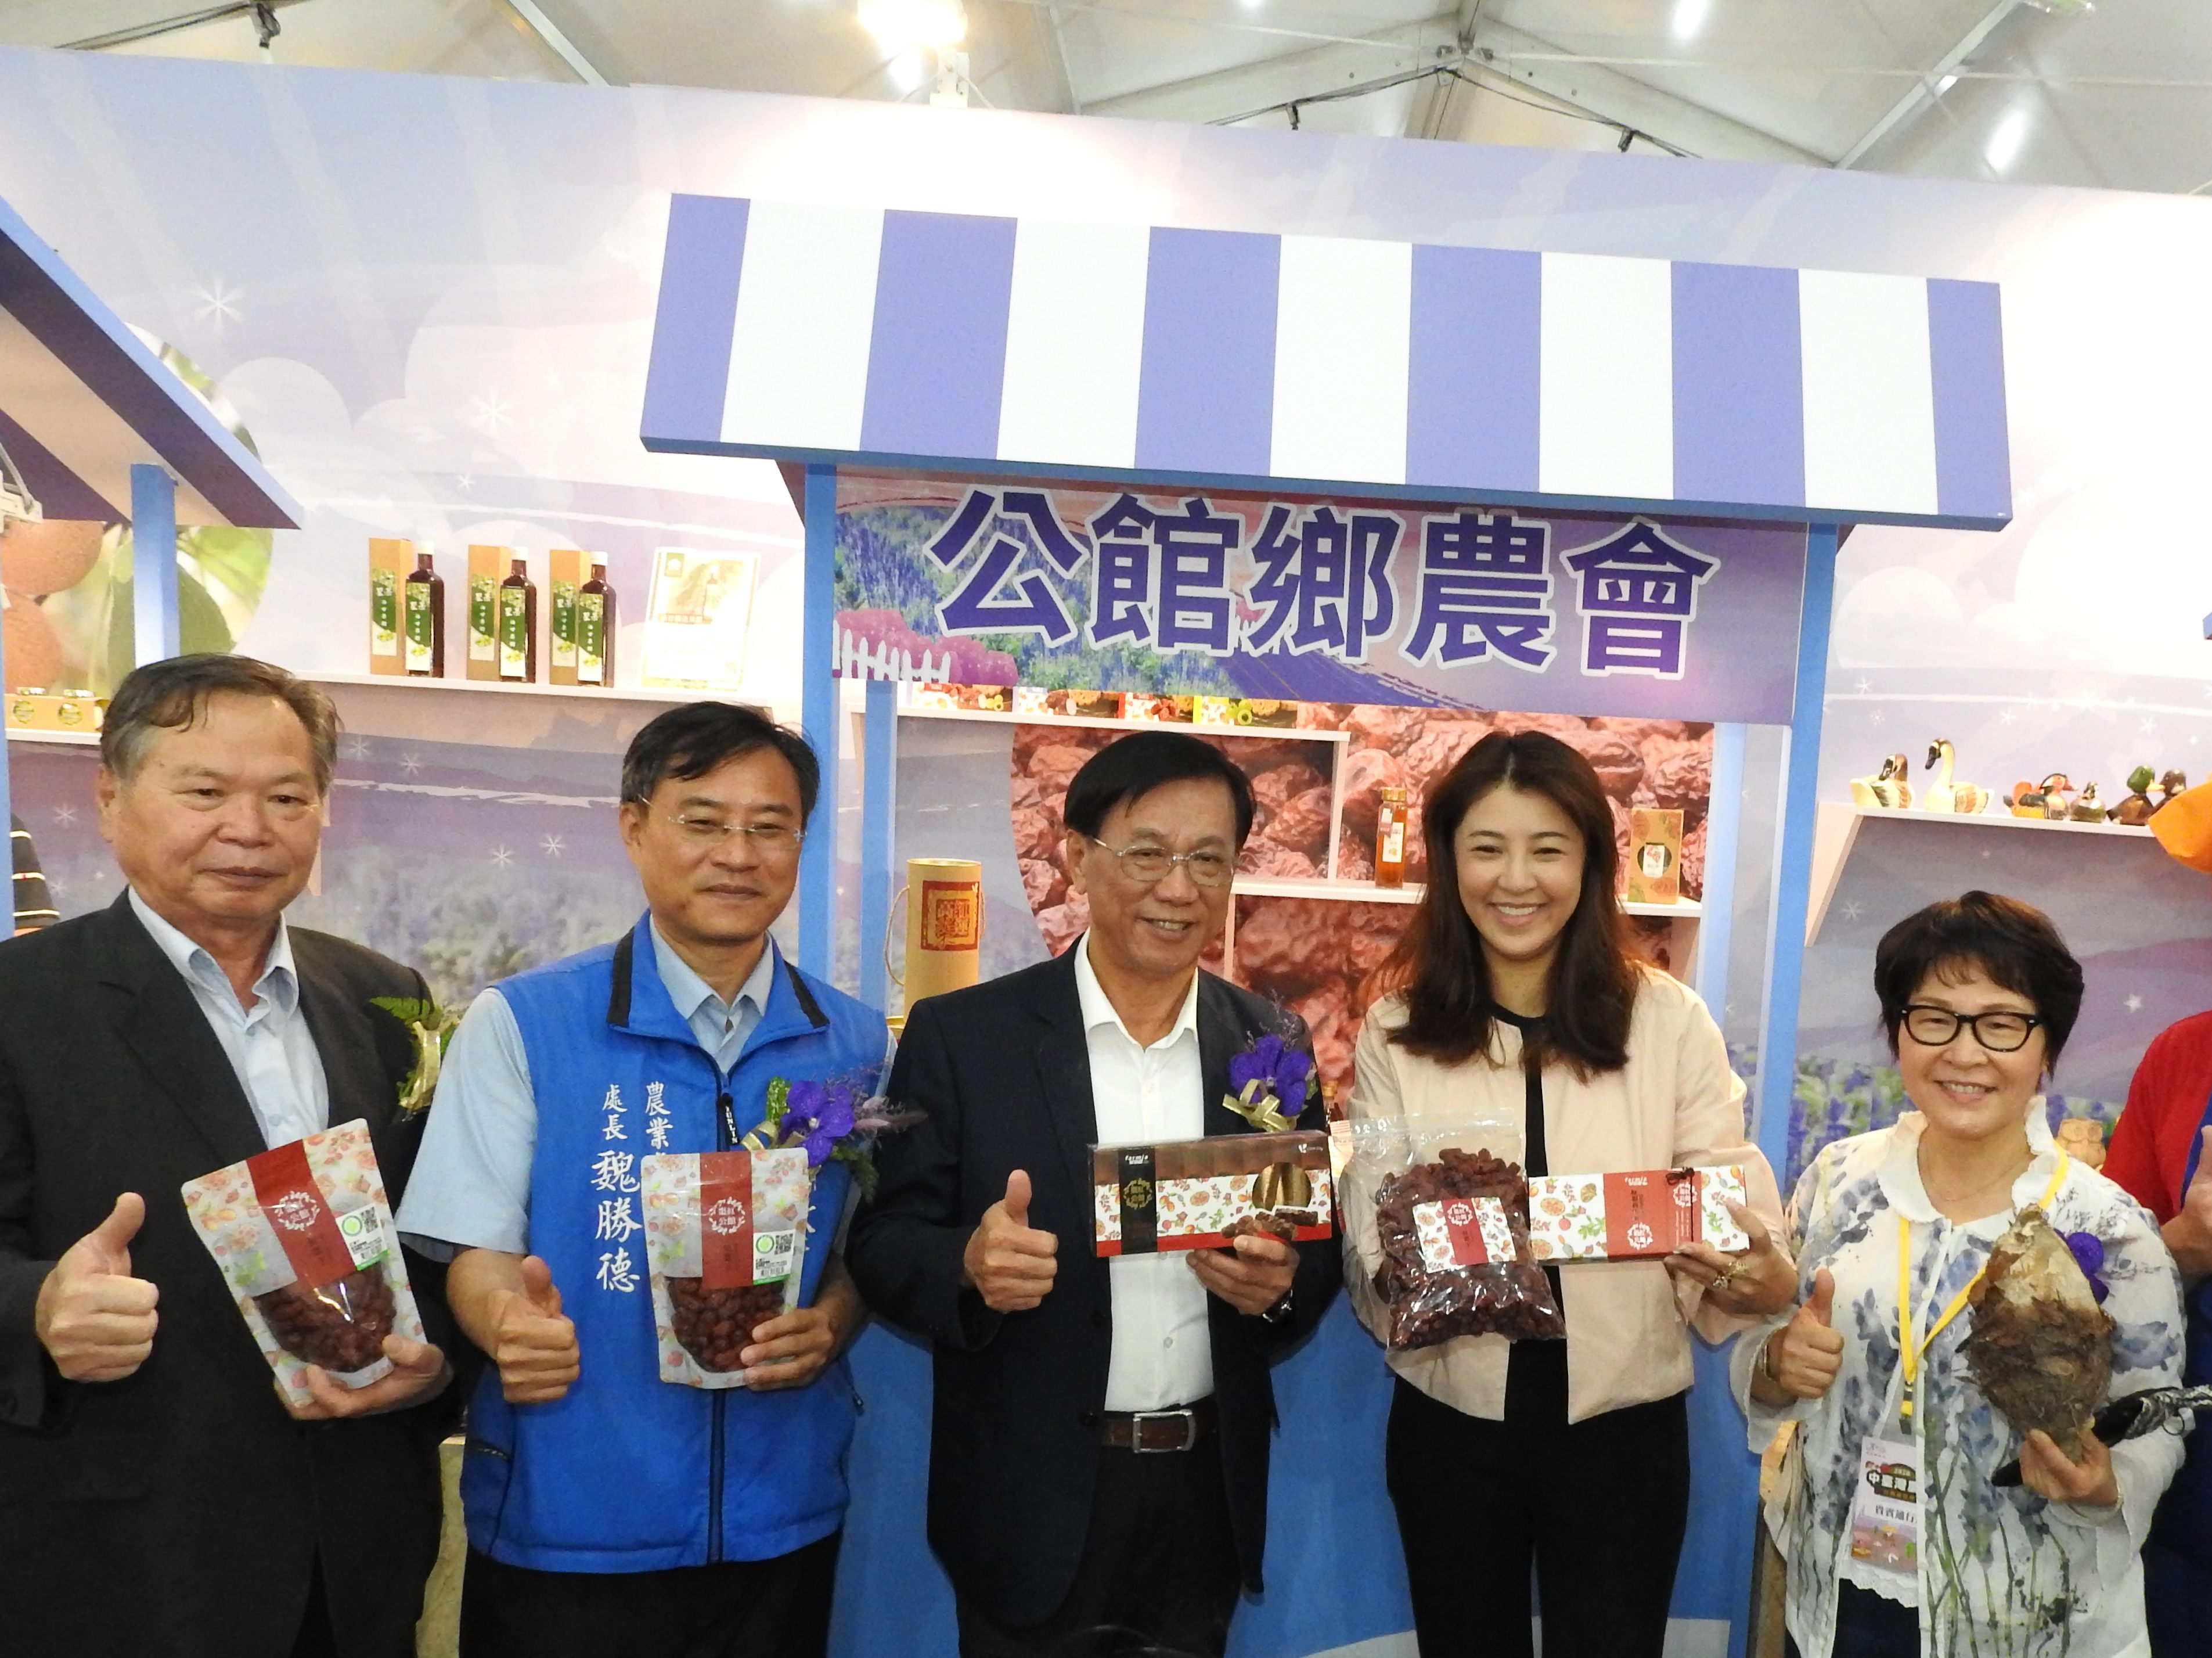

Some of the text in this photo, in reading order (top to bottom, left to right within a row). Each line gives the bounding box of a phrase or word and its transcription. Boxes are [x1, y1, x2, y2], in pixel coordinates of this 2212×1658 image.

[924, 484, 1720, 681] 公館鄉農會
[645, 1081, 674, 1155] 農業
